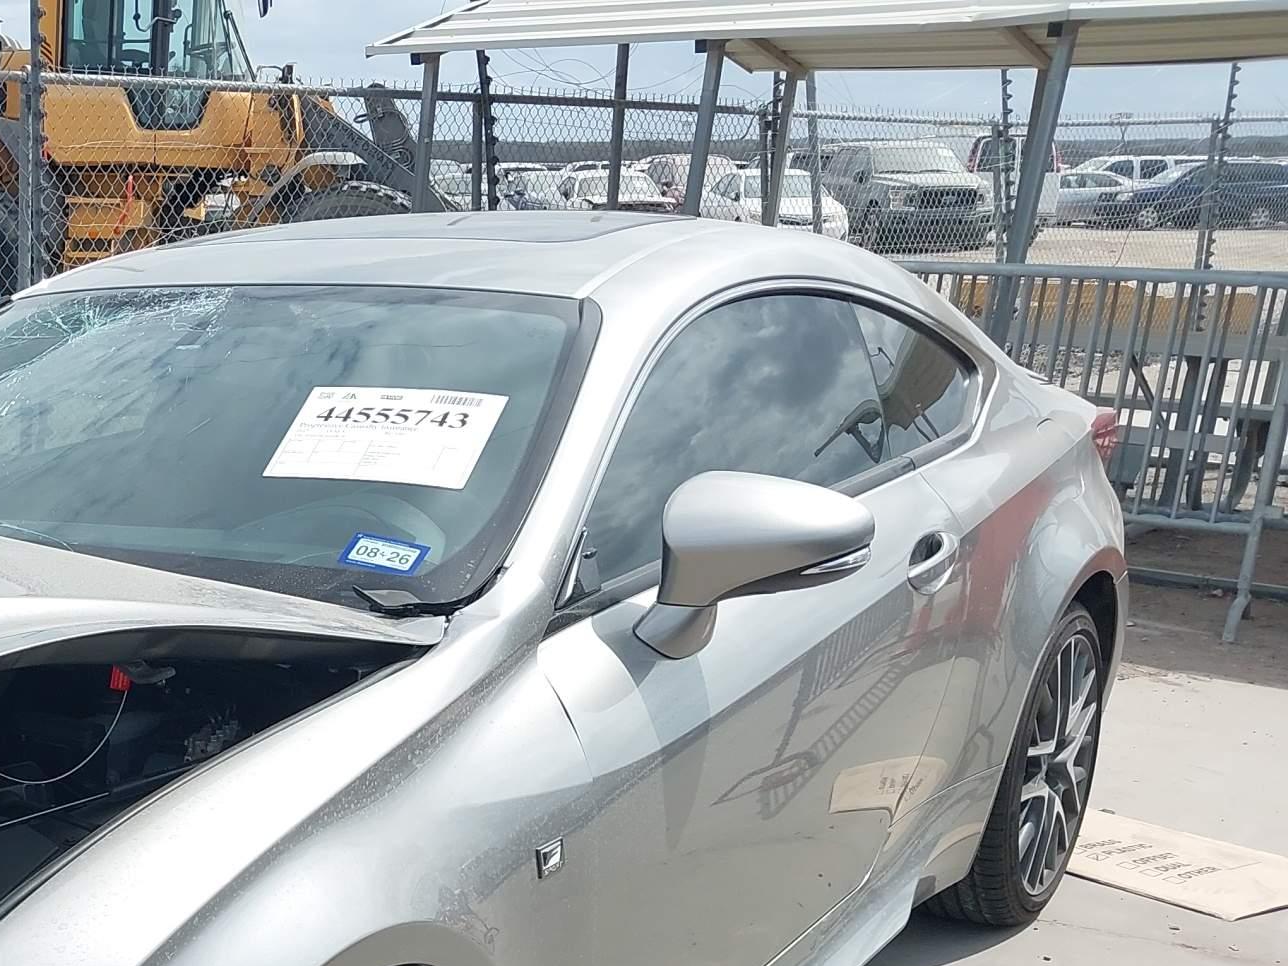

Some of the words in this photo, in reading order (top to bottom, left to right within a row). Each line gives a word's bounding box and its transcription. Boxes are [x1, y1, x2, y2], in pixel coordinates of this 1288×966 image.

[316, 406, 470, 429] 44555743
[355, 545, 380, 558] 08
[386, 551, 412, 565] 26
